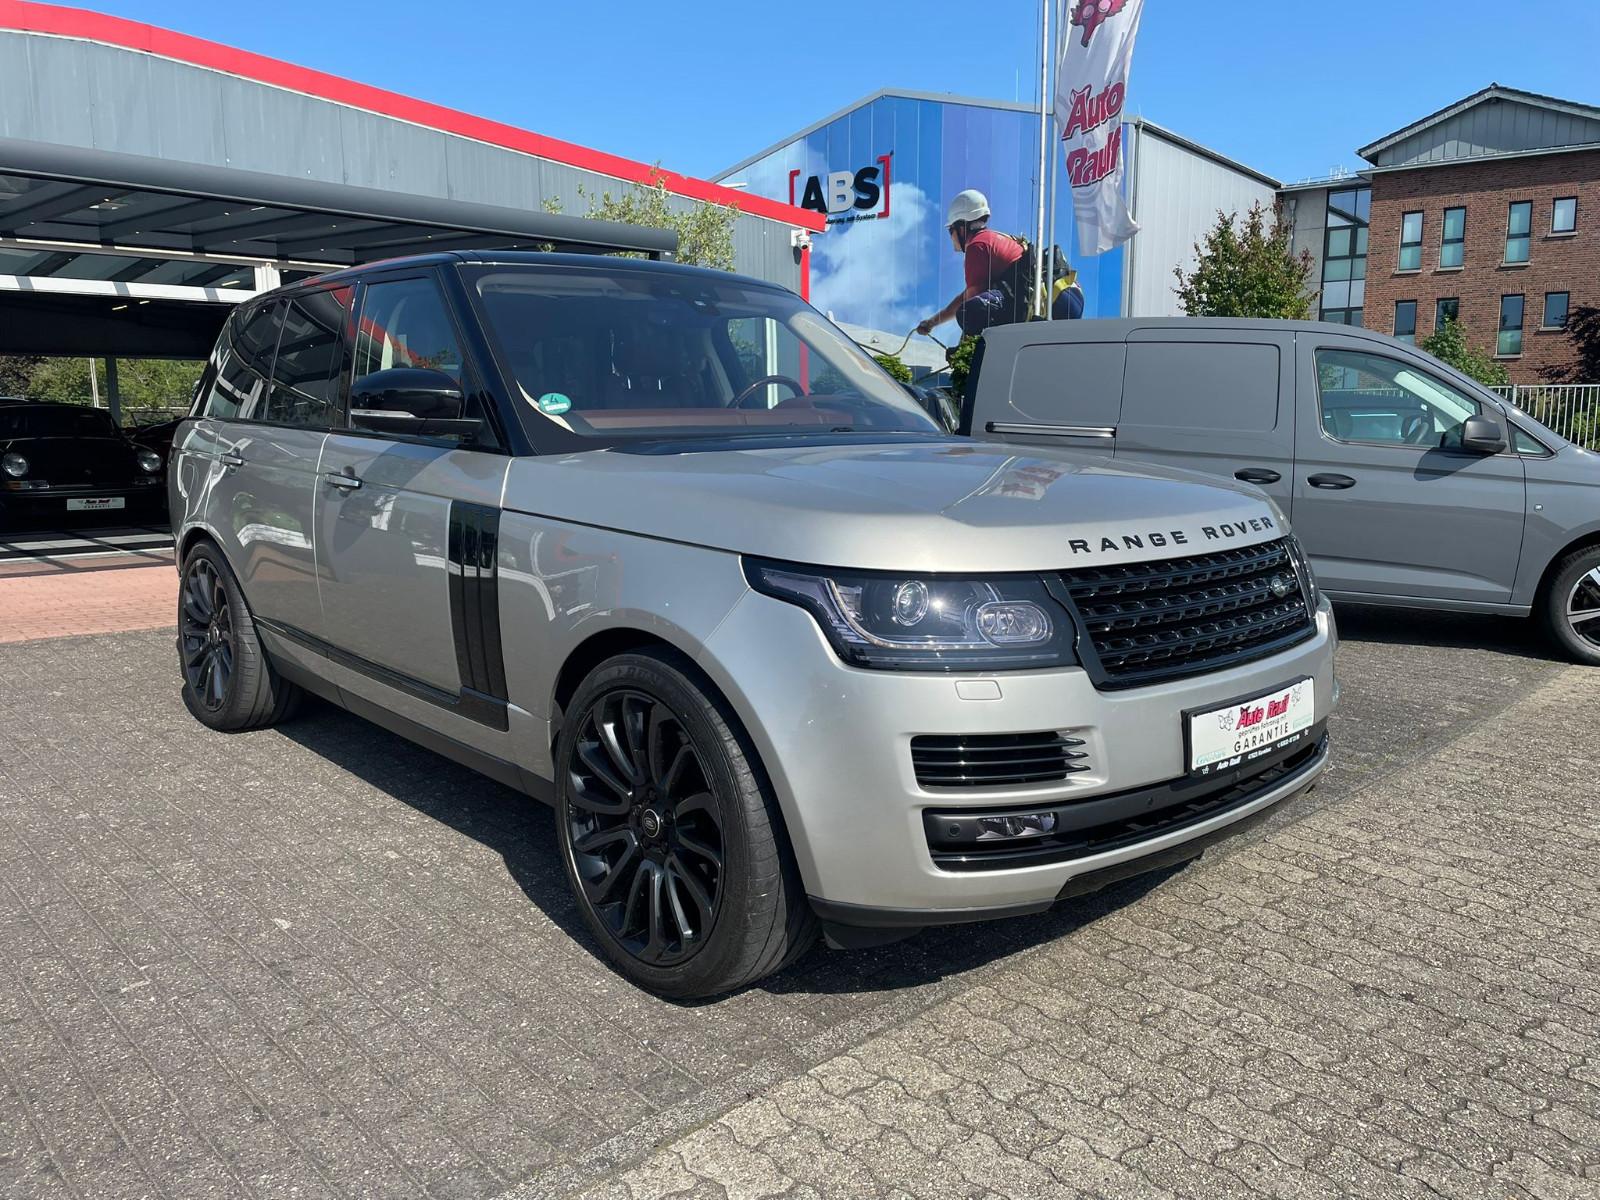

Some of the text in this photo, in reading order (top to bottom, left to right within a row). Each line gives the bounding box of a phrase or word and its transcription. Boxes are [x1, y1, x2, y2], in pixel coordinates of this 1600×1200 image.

[1062, 82, 1125, 141] Auto
[801, 166, 880, 214] ABS
[1068, 516, 1274, 554] RANGE ROVER
[1235, 705, 1265, 730] Auto
[1234, 722, 1289, 752] GARANTIE
